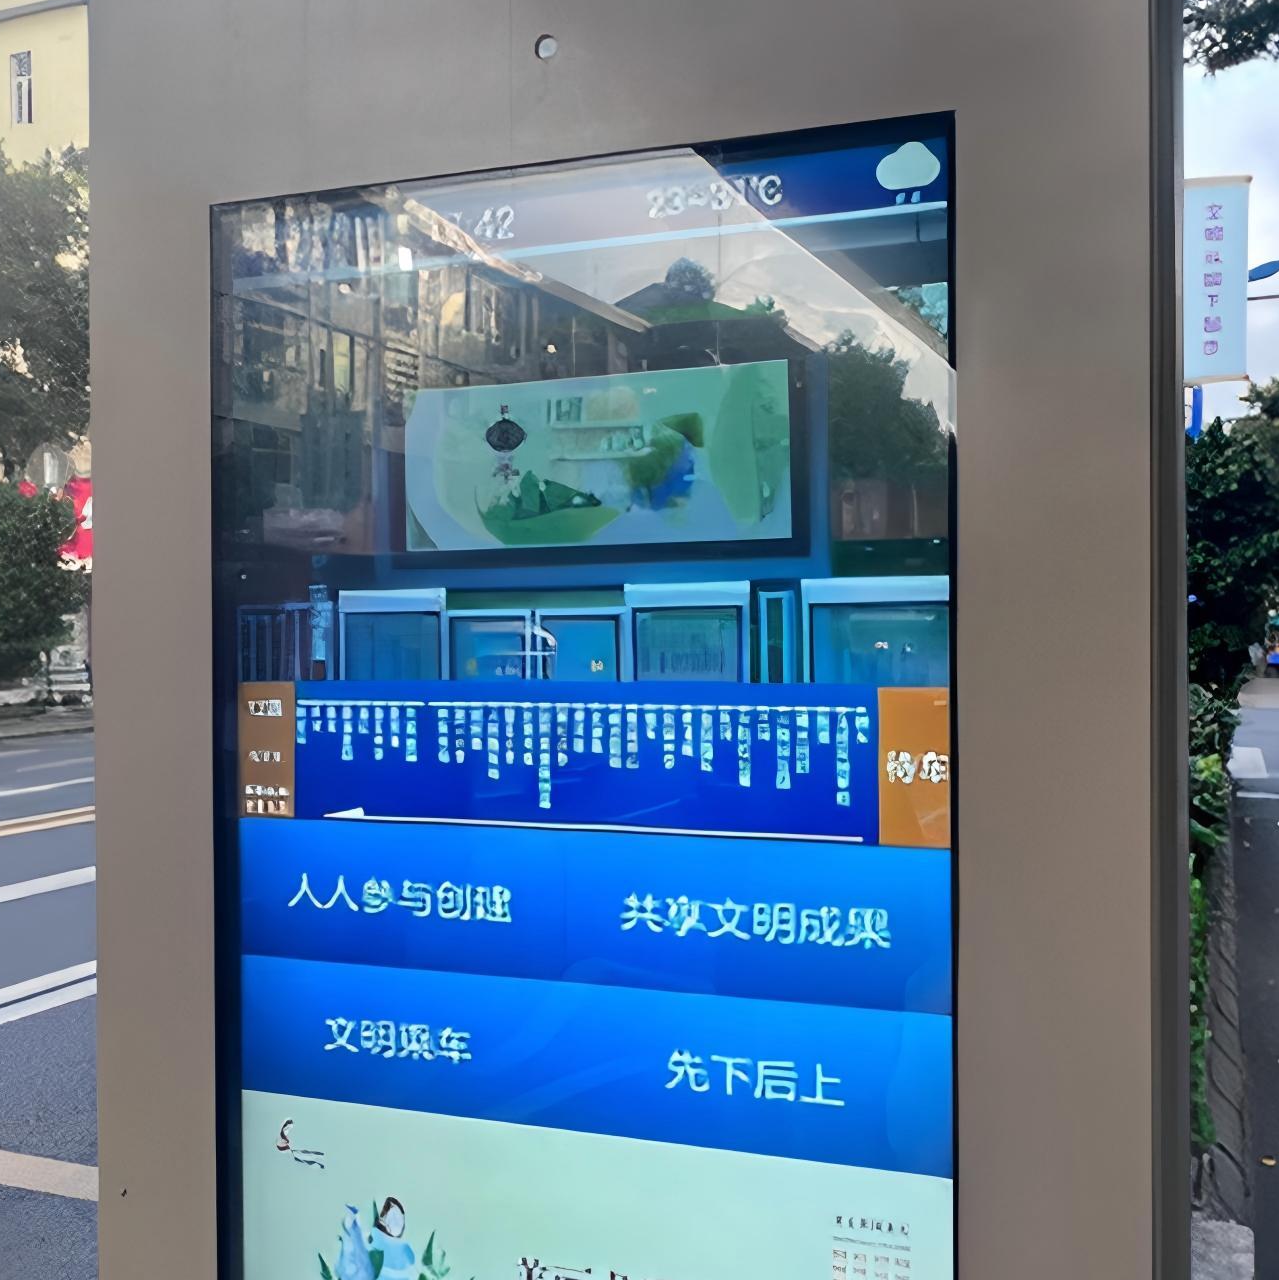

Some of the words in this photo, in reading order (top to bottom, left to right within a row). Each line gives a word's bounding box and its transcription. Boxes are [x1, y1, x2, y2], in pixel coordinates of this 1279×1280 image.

[288, 873, 512, 923] 人人参与创建
[620, 891, 891, 949] 共享文明成果
[665, 1049, 845, 1107] 先下后上
